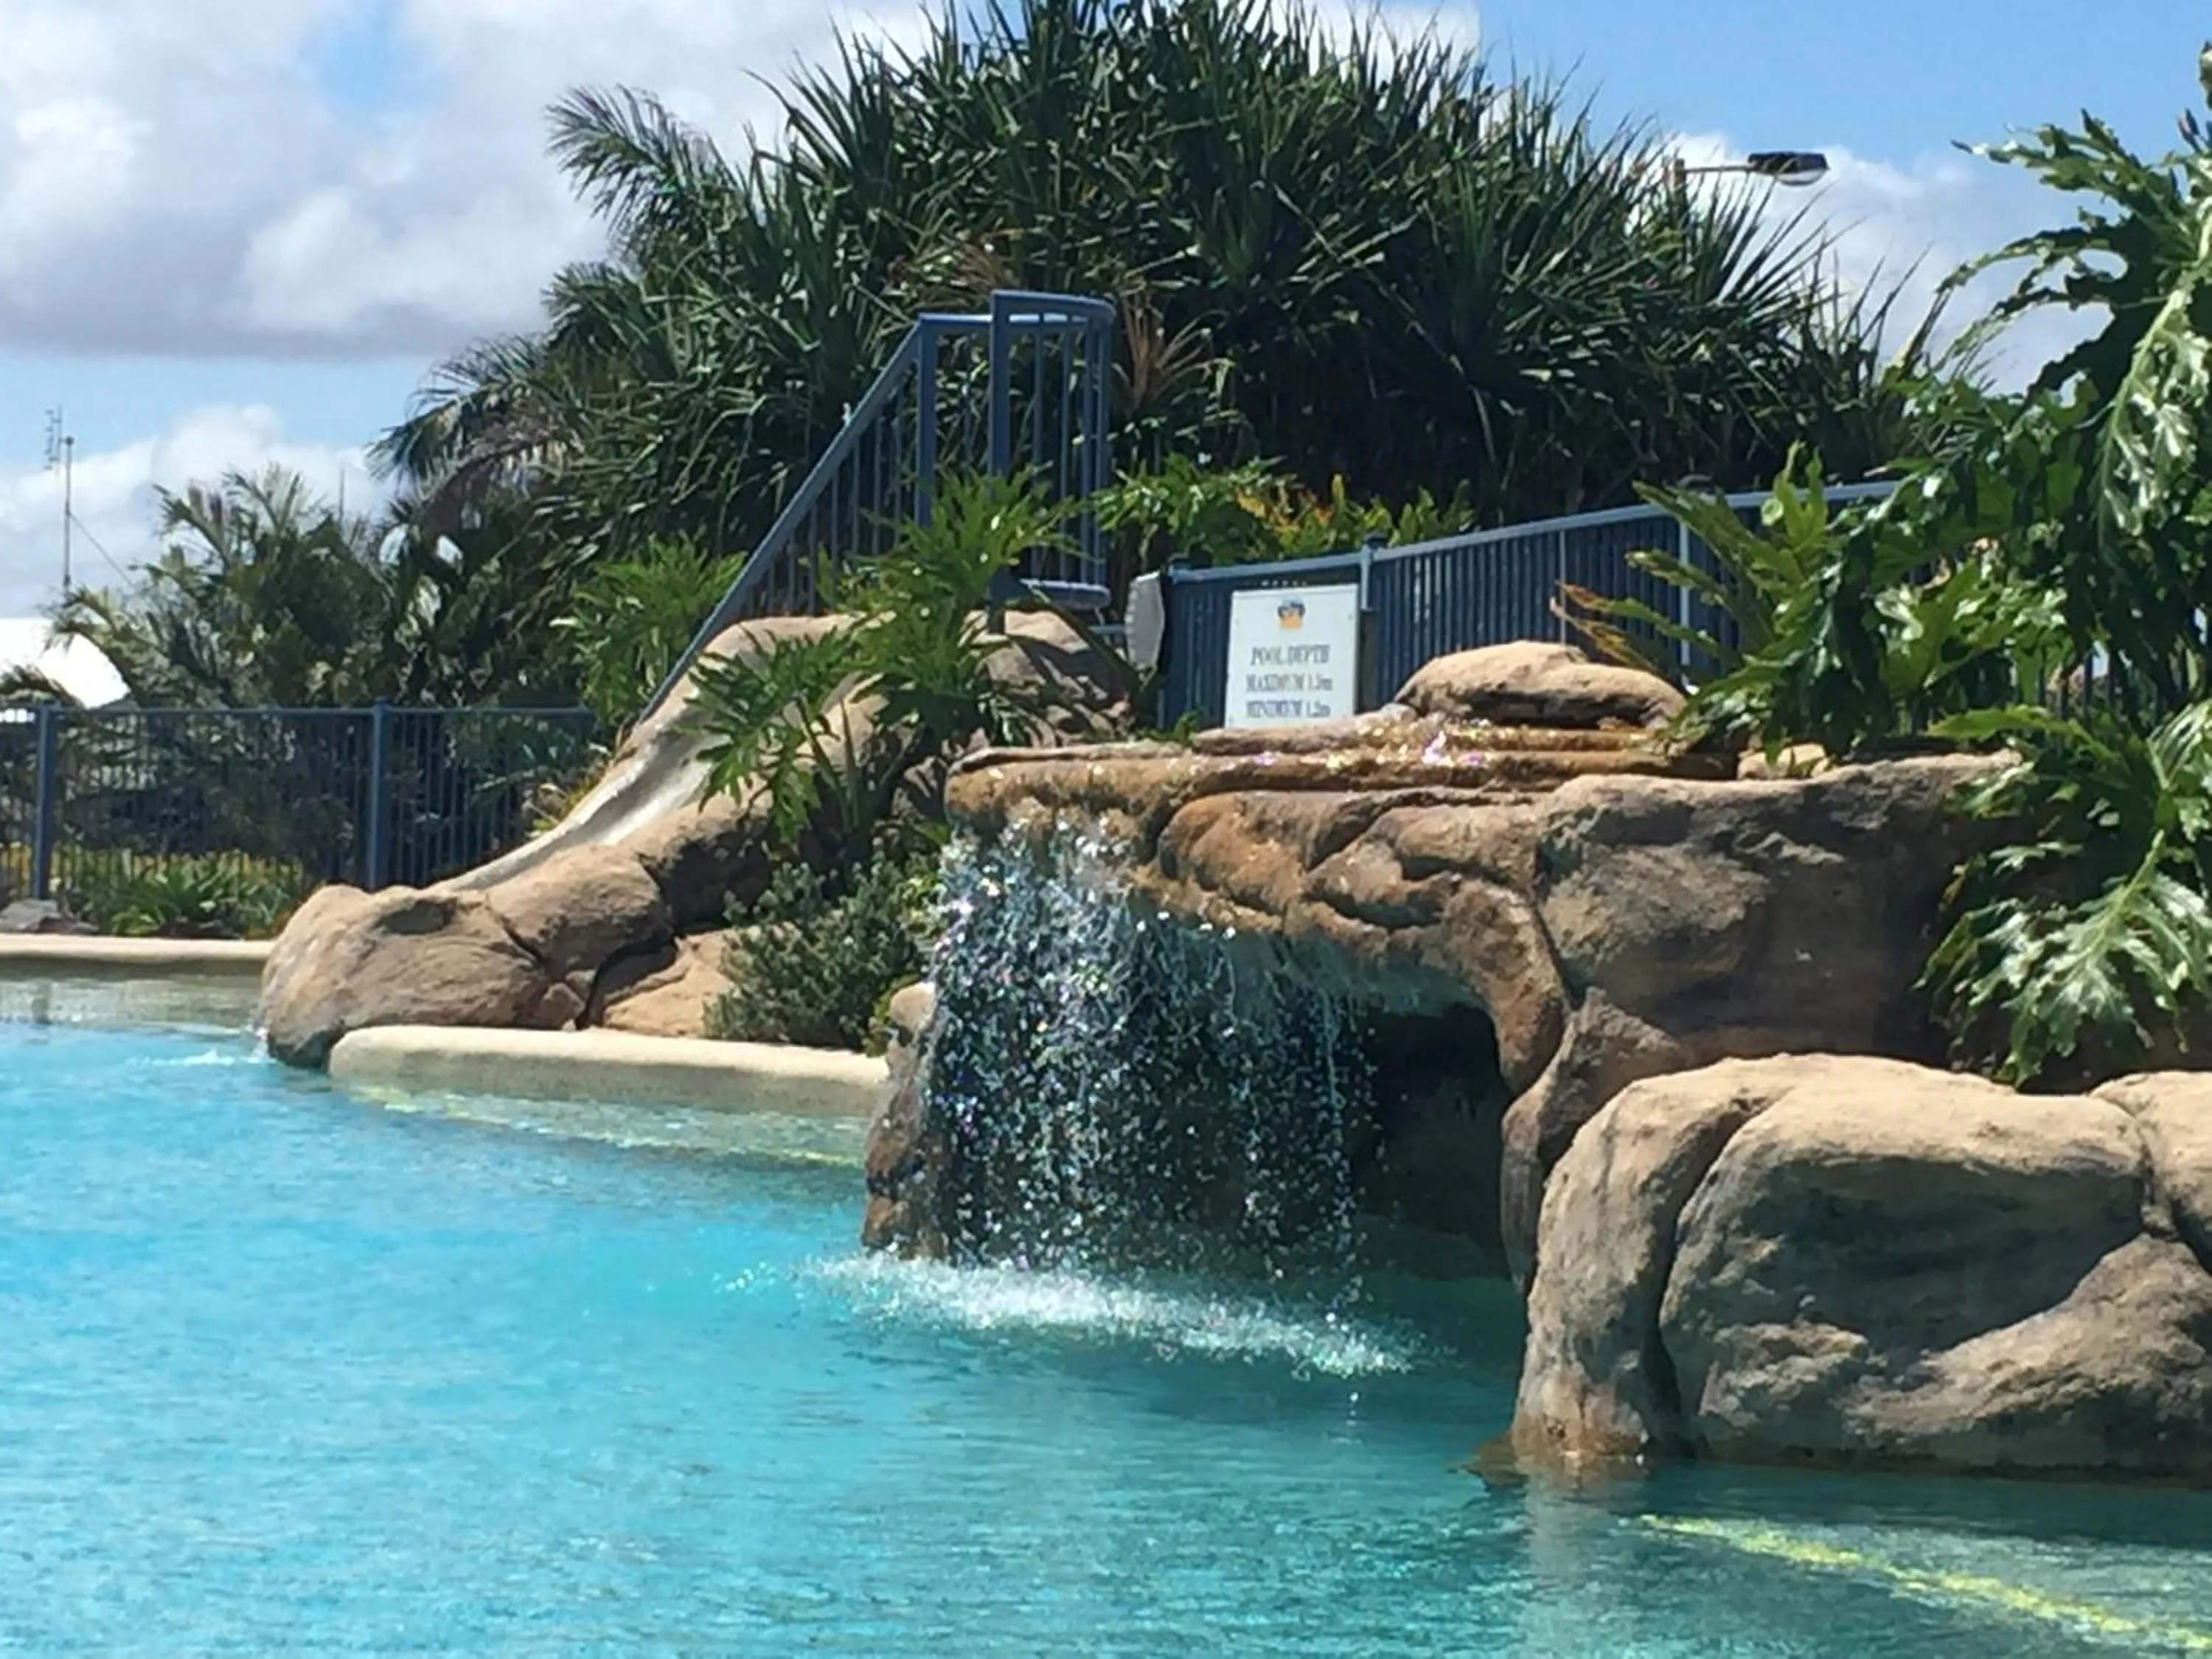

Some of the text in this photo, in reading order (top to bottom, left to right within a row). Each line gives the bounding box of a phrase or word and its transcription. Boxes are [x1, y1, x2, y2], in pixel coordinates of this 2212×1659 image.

[1251, 644, 1330, 666] POOL DEPTH
[1245, 673, 1304, 692] MAXIMUM
[1246, 700, 1303, 718] MINIMUM
